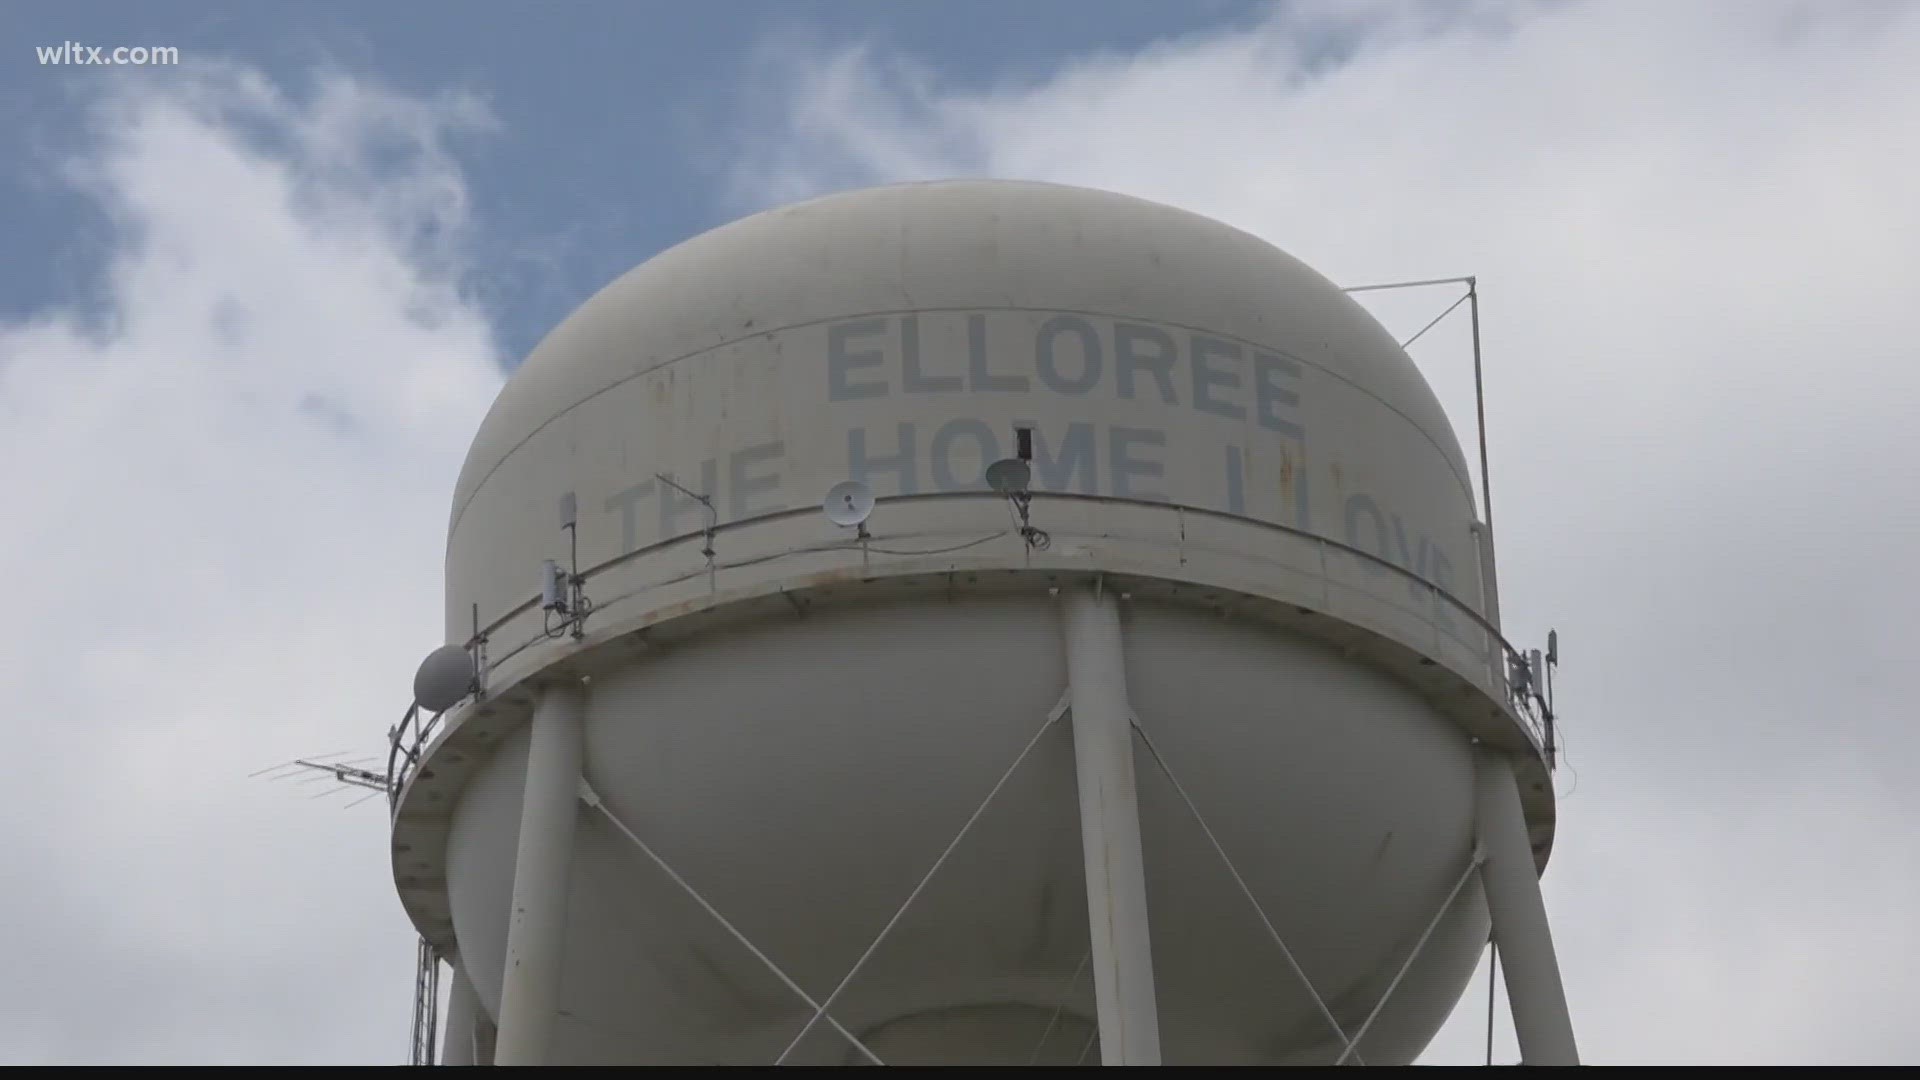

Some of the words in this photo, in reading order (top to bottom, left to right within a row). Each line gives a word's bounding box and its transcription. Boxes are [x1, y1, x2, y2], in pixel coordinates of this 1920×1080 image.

[827, 312, 1304, 440] ELLOREE
[604, 441, 788, 555] THE
[847, 417, 1168, 500] HOME
[1226, 444, 1246, 515] I
